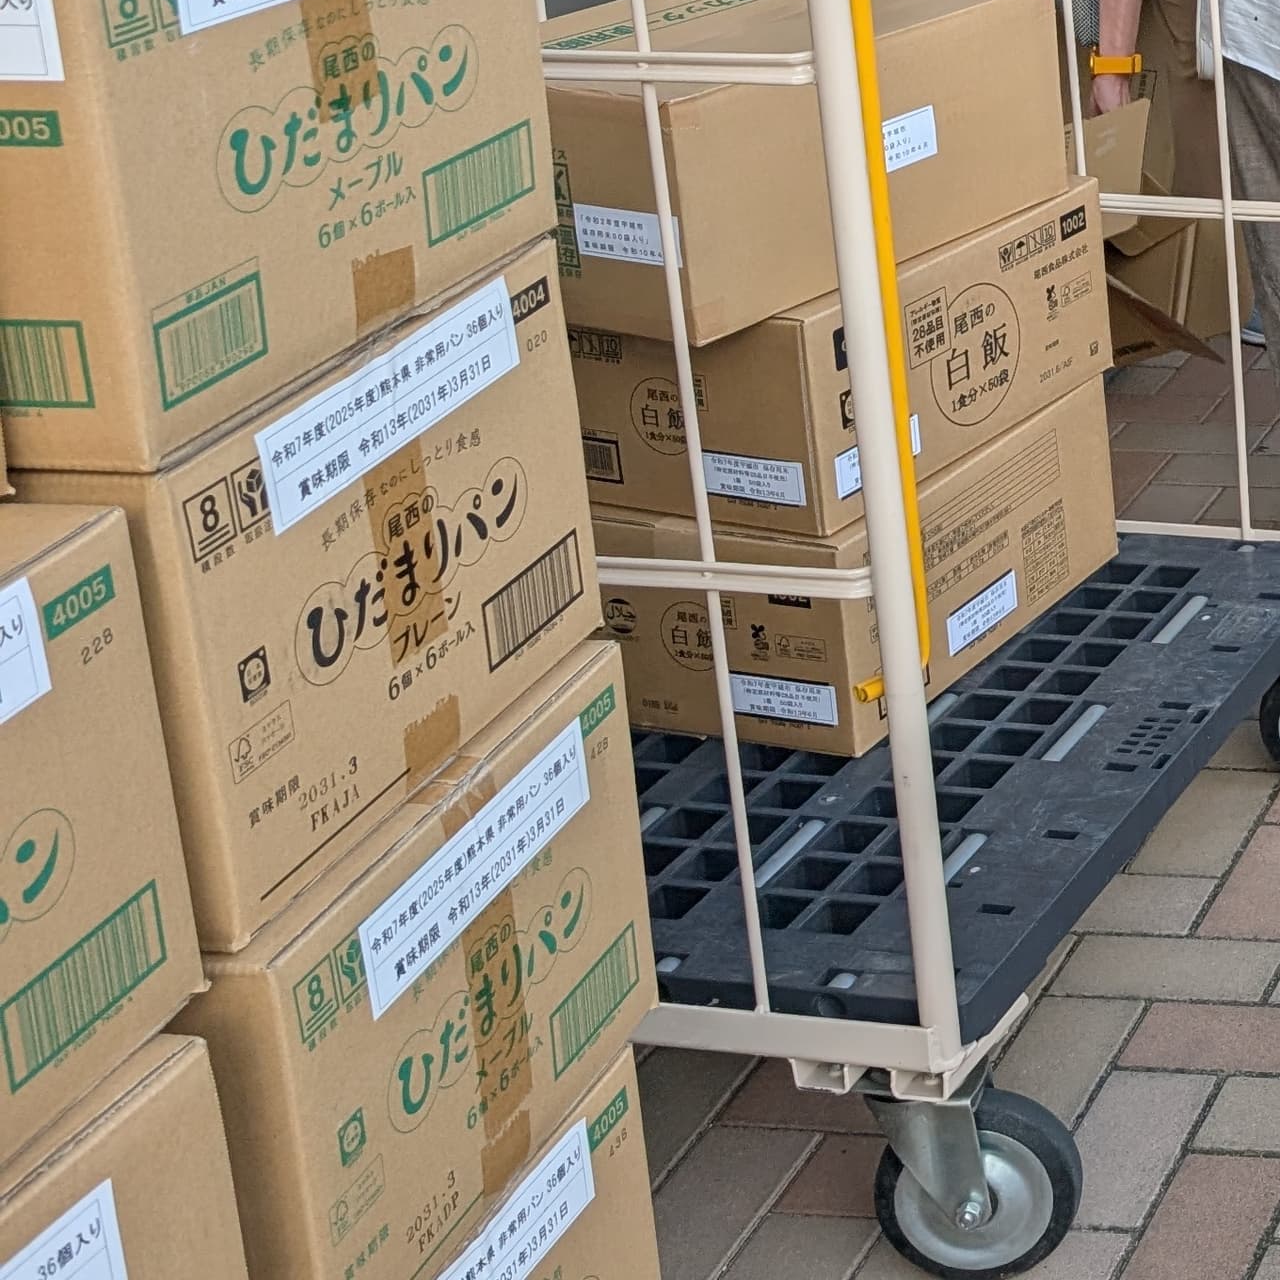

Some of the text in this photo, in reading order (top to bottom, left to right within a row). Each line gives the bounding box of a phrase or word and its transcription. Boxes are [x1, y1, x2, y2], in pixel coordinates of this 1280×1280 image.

[323, 41, 376, 81] 尾西の
[229, 44, 469, 196] ひだまりパン
[328, 151, 404, 211] メープル
[1062, 212, 1085, 235] 1002
[513, 283, 546, 319] 4004
[953, 302, 996, 339] 尾西の
[526, 329, 548, 353] 020
[912, 316, 945, 343] 28品目
[914, 332, 946, 359] 不使用
[271, 361, 412, 468] 令和7年度(2025年度)熊本県
[414, 332, 464, 375] 非常用パン
[466, 302, 504, 339] 36個入り
[298, 354, 492, 502] 賞味期限 令和13年(2031年)3月31日
[199, 494, 220, 533] 8
[388, 495, 434, 542] 尾西の
[306, 472, 518, 668] ひだまりパン
[52, 575, 107, 627] 4005
[393, 590, 461, 664] プレーン
[81, 627, 113, 665] 228
[388, 620, 476, 701] 6個×6ボール入
[248, 774, 301, 829] 賞味期限
[370, 824, 496, 955] 令和7年度(2025年度)熊本県
[496, 782, 542, 834] 非常用パン
[543, 746, 578, 788] 36個入り
[392, 921, 442, 982] 賞味期限
[447, 796, 566, 924] 令和13年(2031年)3月31日
[307, 974, 325, 1012] 8
[398, 882, 584, 1115] ひだまりパン
[592, 1098, 625, 1142] 4005
[496, 1193, 544, 1250] 非常用パン
[545, 1148, 582, 1194] 36個入り
